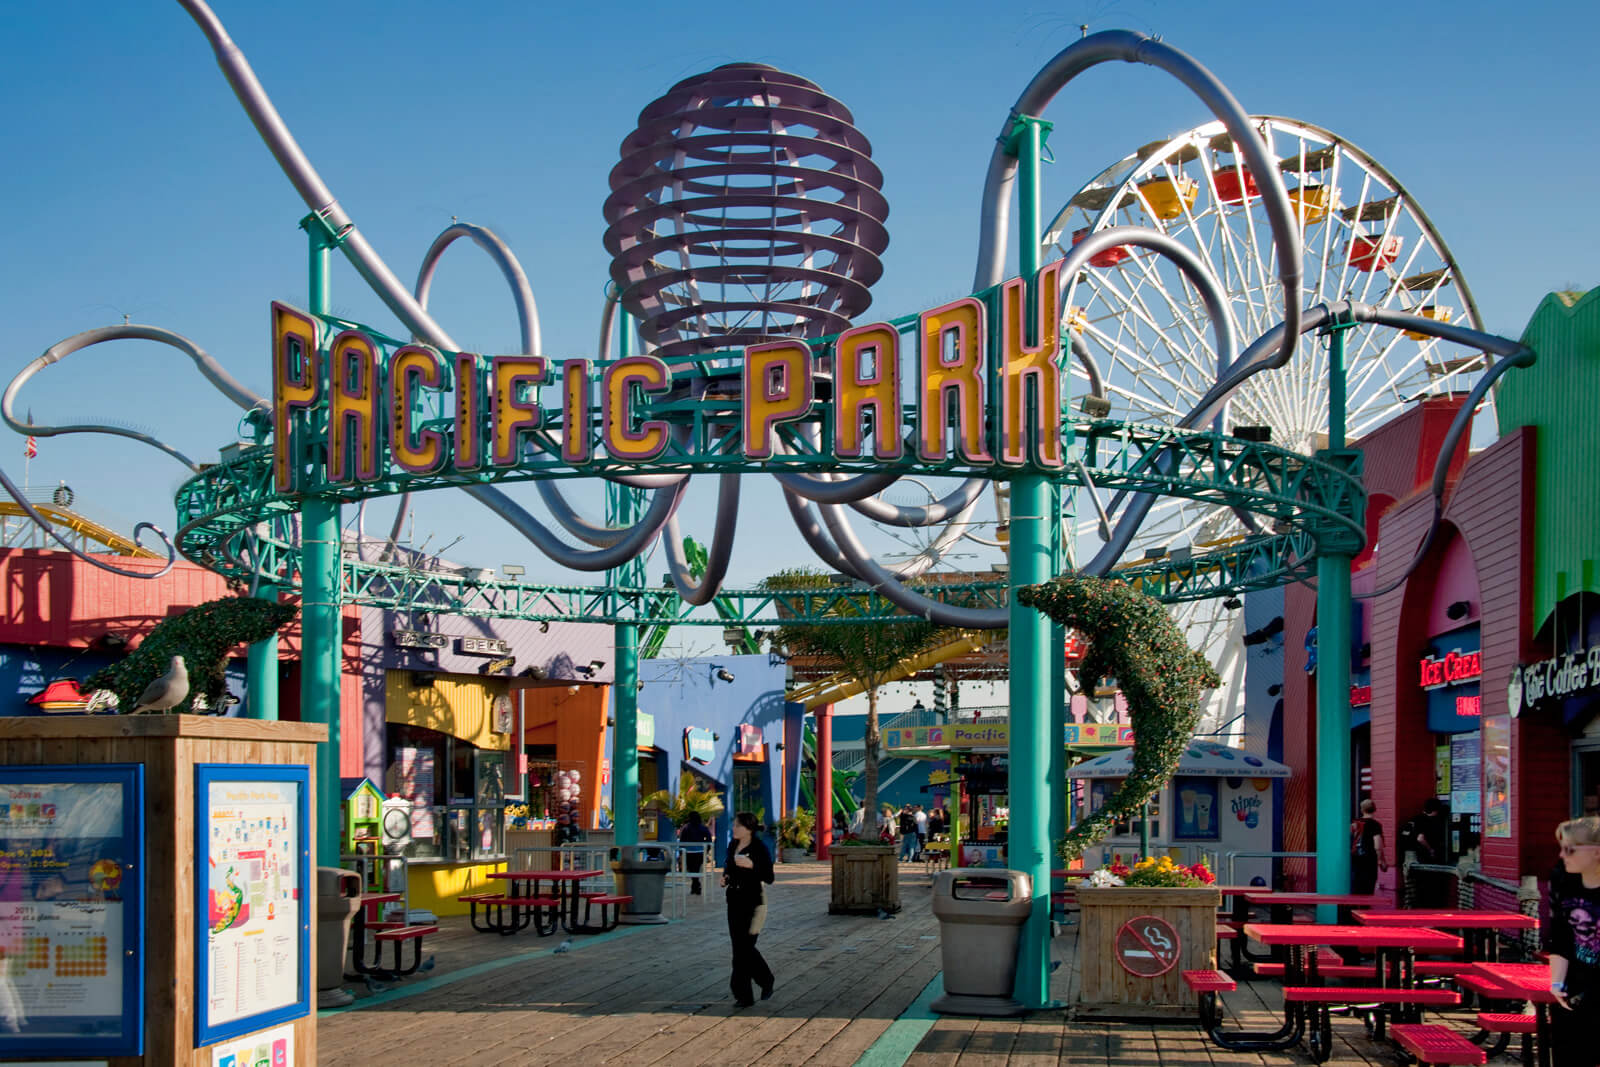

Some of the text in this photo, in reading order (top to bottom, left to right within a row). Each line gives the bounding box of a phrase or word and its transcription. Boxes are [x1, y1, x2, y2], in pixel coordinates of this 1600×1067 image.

[271, 258, 1065, 494] PACIFIC PARK
[393, 630, 509, 654] TACO BELL
[1420, 651, 1482, 687] ICE CREA
[1523, 661, 1545, 708] The
[1545, 652, 1588, 697] Coffee
[955, 728, 1006, 741] Pacific
[15, 906, 35, 915] 2011
